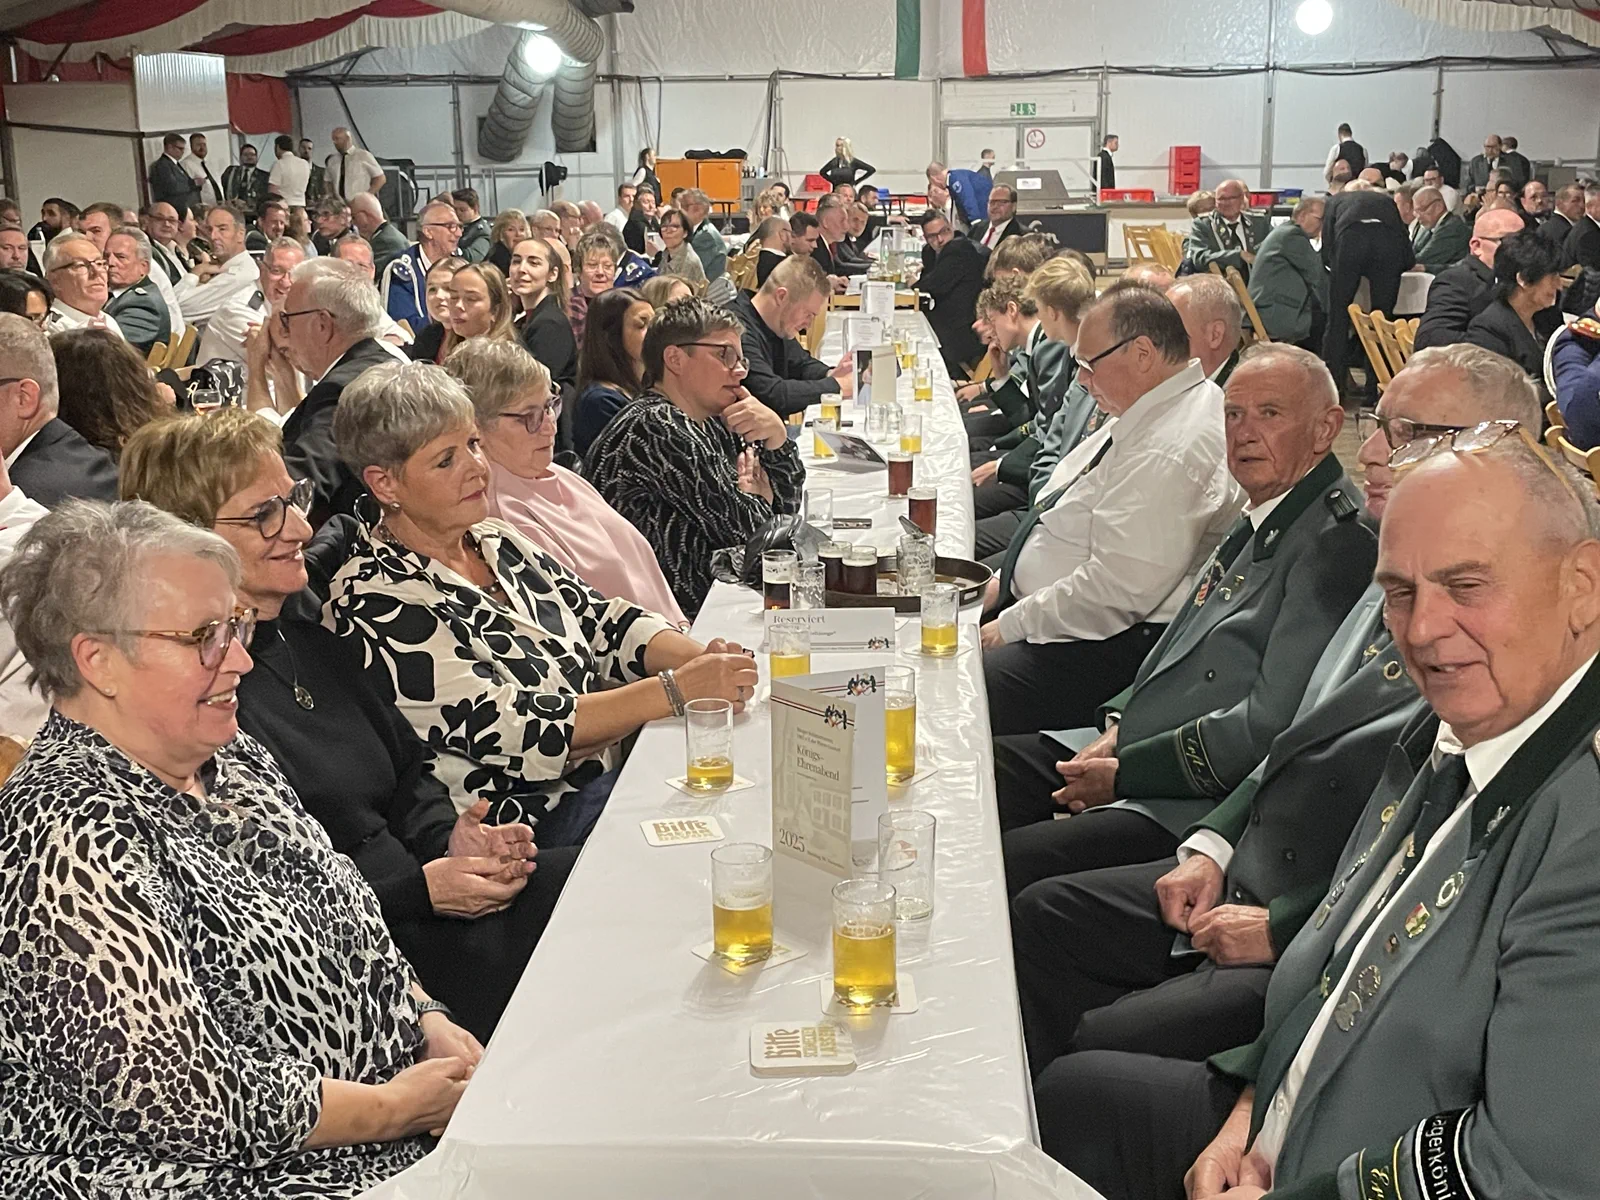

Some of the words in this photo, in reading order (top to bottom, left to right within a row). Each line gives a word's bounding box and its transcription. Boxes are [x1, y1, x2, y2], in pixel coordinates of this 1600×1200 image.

[773, 615, 825, 624] Reserviert
[796, 744, 825, 761] Königs-
[796, 757, 840, 781] Ehrenabend
[779, 828, 805, 852] 2025
[764, 1029, 801, 1059] Bitte
